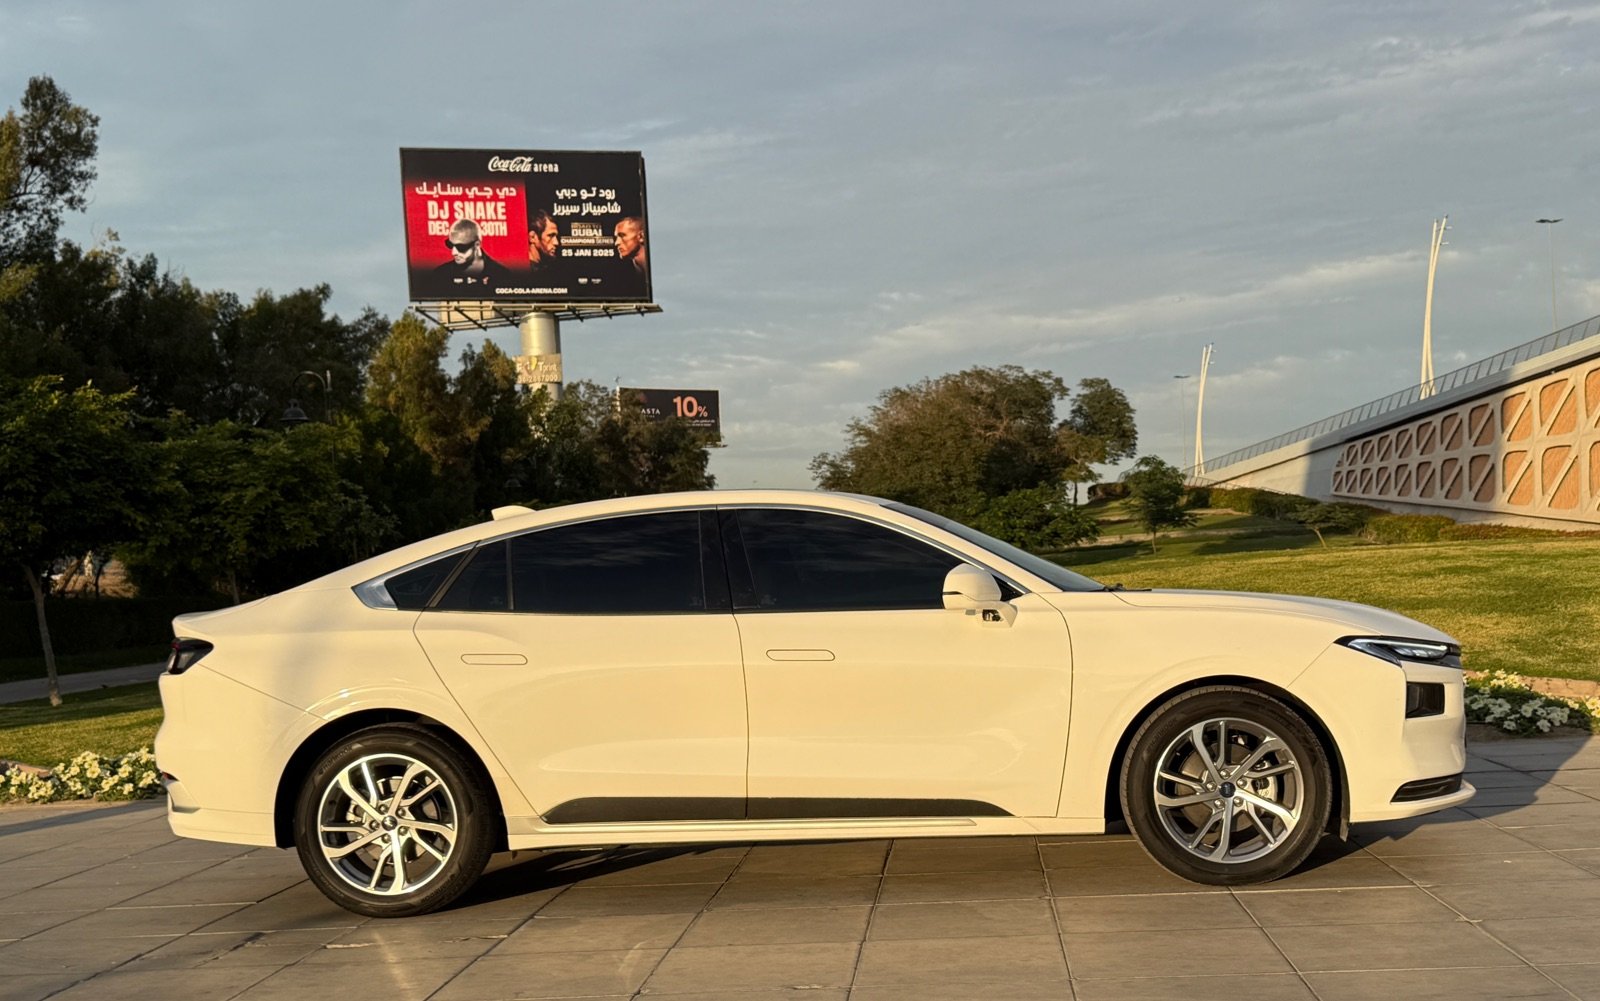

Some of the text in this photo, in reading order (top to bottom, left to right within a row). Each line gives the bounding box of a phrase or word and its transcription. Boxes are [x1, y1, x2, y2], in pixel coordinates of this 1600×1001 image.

[533, 163, 559, 172] arena
[415, 182, 517, 199] دي جي سنايك
[555, 187, 615, 200] رود تو دبي
[427, 201, 507, 220] DJ SNAKE
[428, 221, 508, 236] DEC 30TH
[571, 229, 602, 237] DUBAI
[561, 249, 615, 257] 25 JAN 2025
[673, 396, 708, 417] 10%
